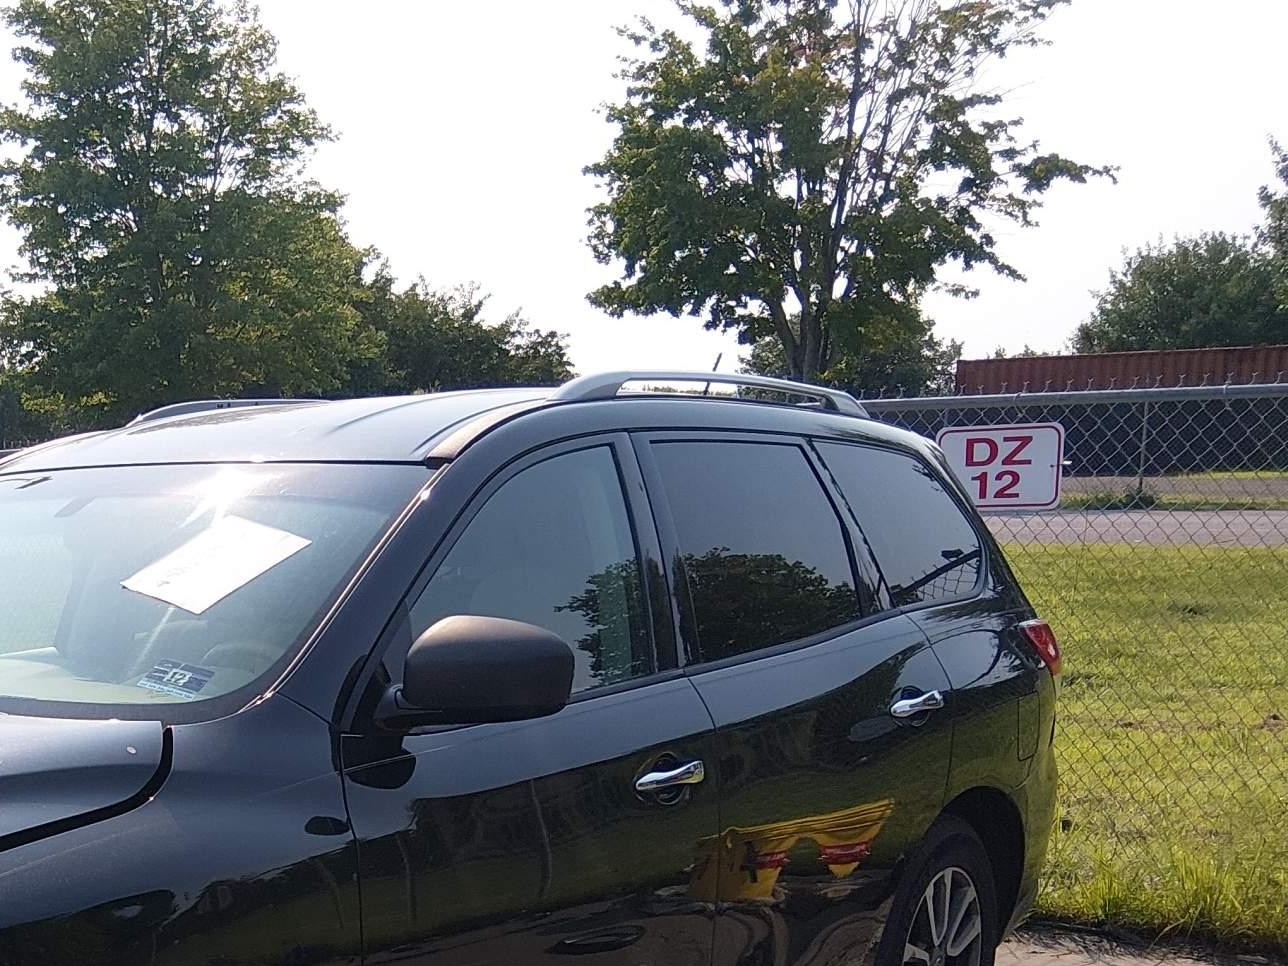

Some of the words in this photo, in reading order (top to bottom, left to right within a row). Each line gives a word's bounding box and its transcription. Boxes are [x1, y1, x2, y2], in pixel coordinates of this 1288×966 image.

[965, 435, 1033, 467] DZ
[970, 470, 1020, 500] 12
[166, 671, 186, 684] 12
